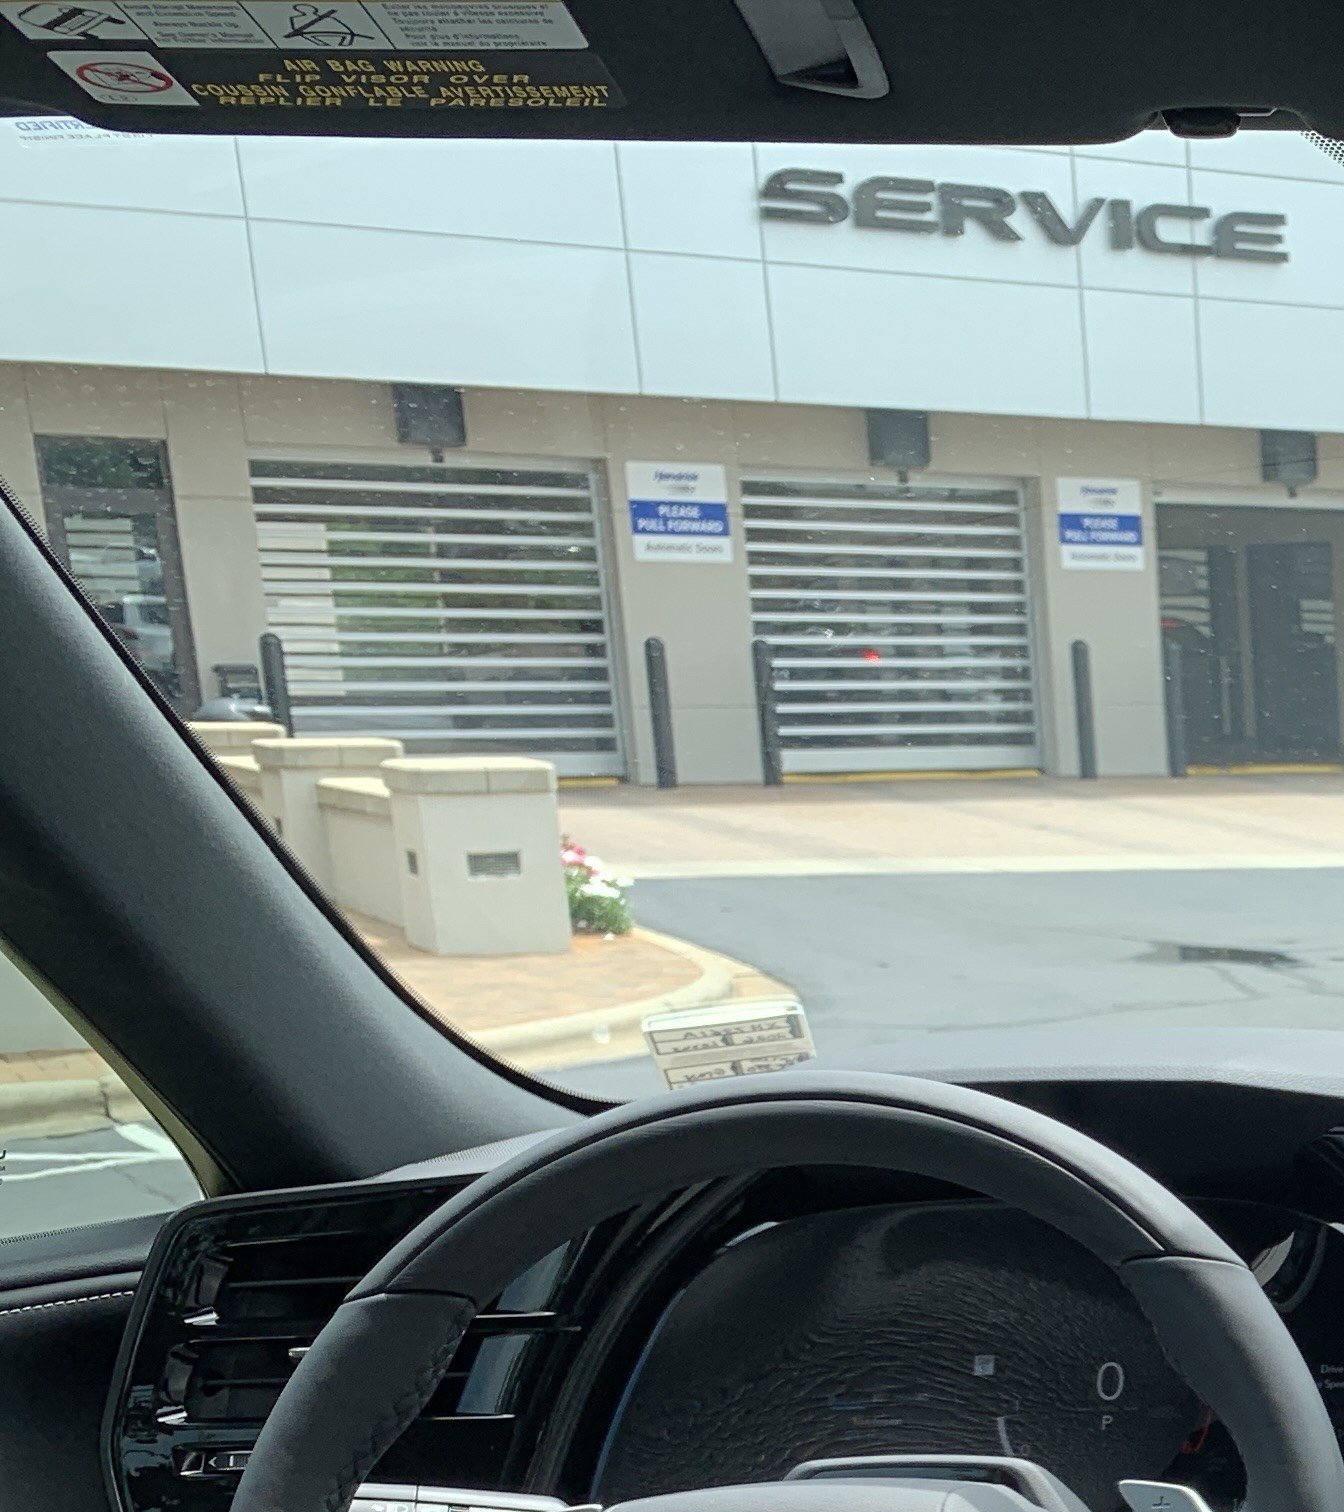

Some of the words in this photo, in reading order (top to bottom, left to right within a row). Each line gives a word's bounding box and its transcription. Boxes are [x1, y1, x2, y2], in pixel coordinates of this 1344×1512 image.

[284, 59, 319, 71] AIR
[326, 60, 376, 72] BAG
[384, 59, 486, 73] WARNING
[259, 73, 321, 83] FLIP
[341, 74, 430, 84] VISOR
[450, 74, 530, 84] OVER
[191, 84, 290, 97] COUSSIN
[299, 85, 430, 98] GONFLABLE
[439, 85, 609, 98] AVERTISSEMENT
[219, 97, 342, 106] REPLIER
[368, 97, 403, 106] LE
[430, 97, 608, 107] PARESOLEIL
[759, 166, 1289, 264] SERVICE
[658, 504, 701, 518] PLEASE
[637, 518, 665, 532] PULL
[667, 519, 724, 533] FORWARD
[1097, 1361, 1125, 1401] 0
[1102, 1414, 1114, 1431] P
